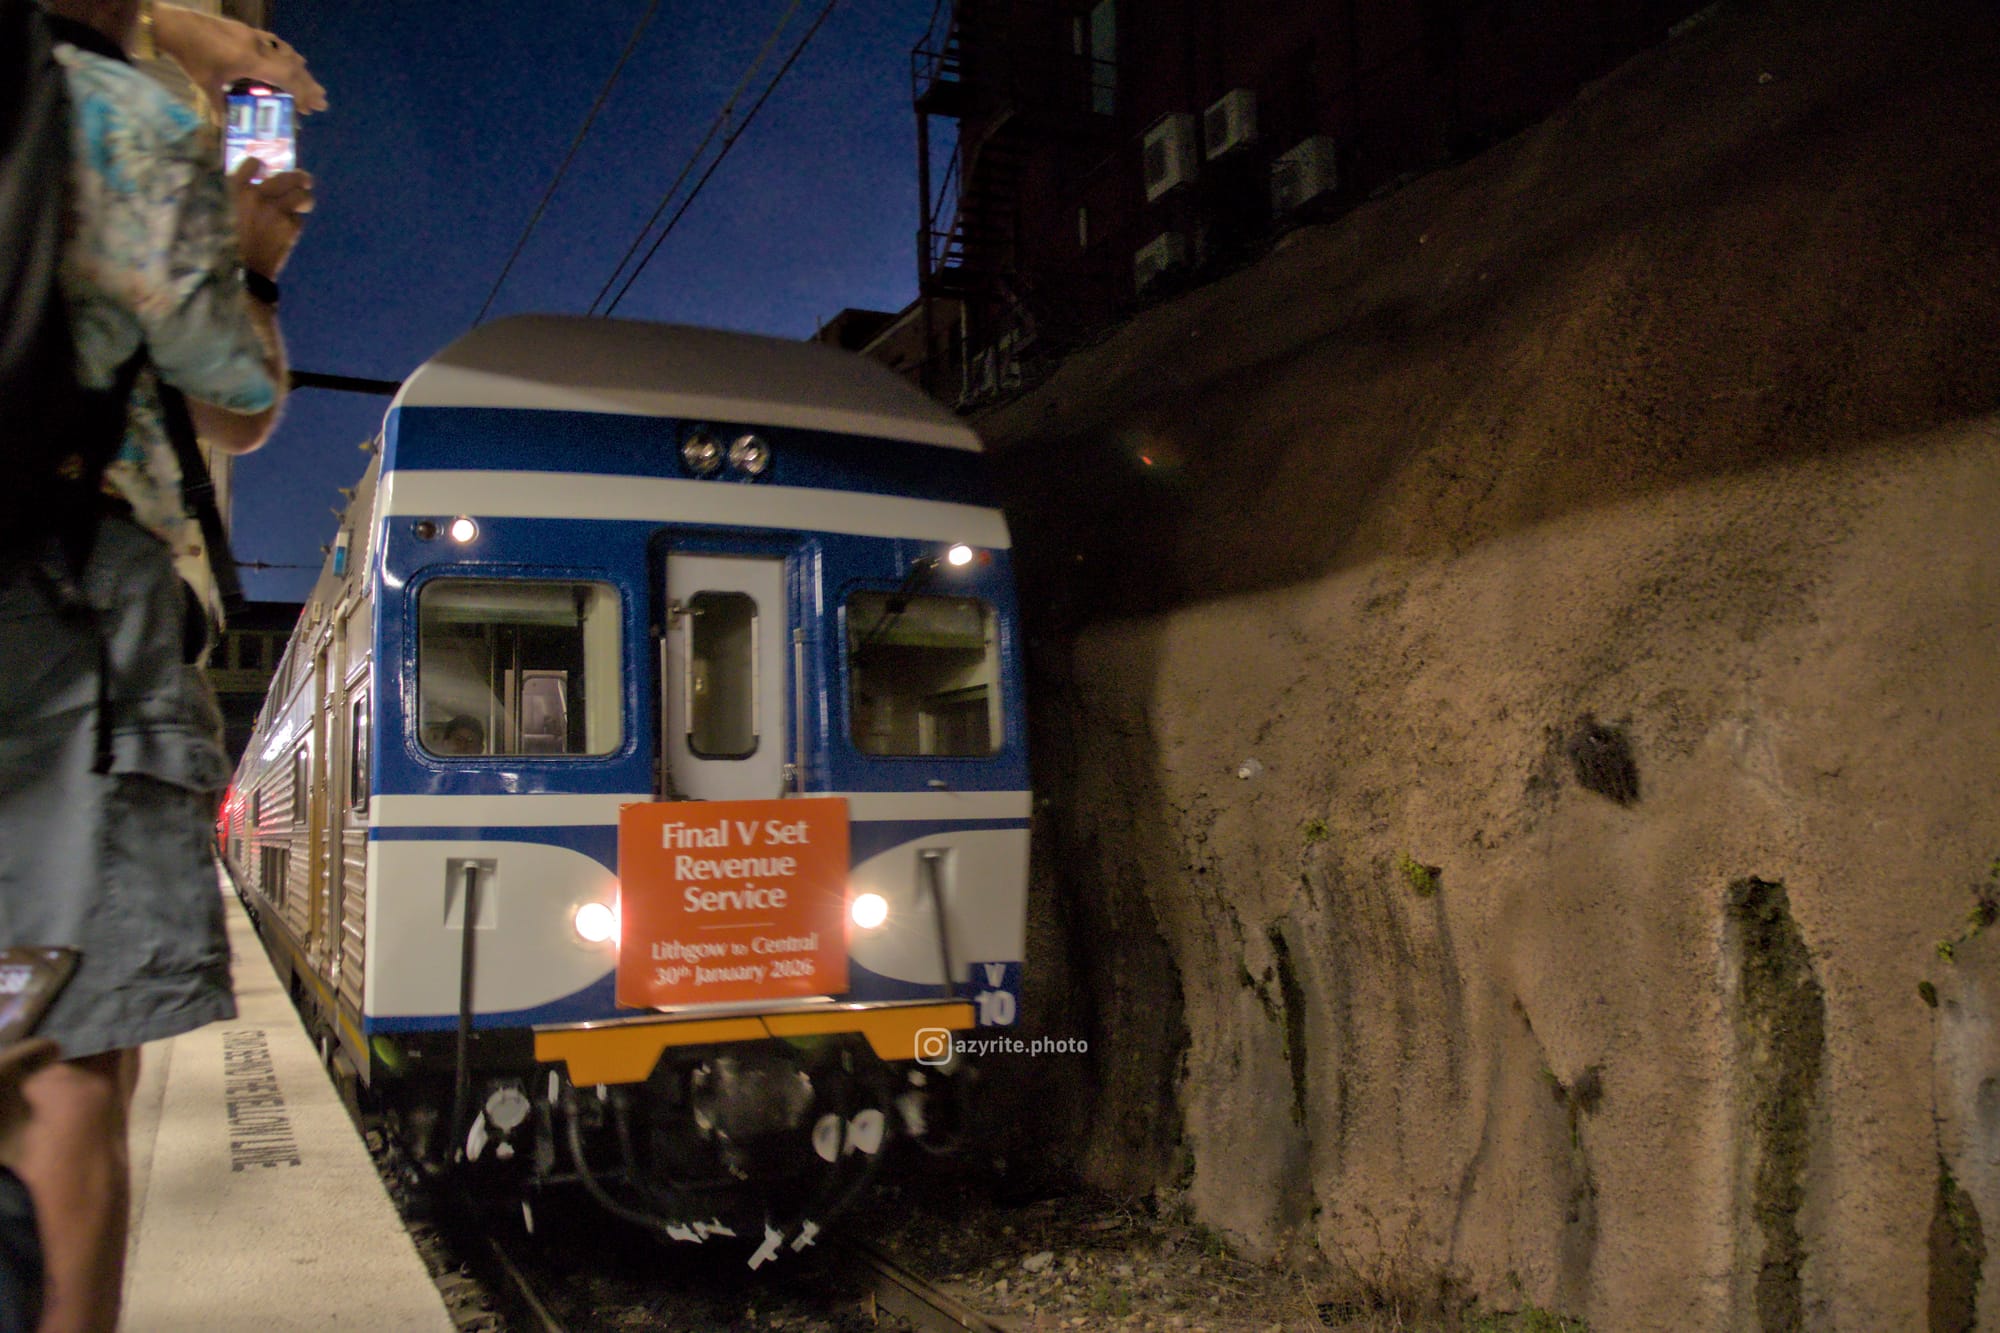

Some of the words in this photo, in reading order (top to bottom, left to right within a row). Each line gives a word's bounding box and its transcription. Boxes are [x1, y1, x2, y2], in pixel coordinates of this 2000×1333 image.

[662, 820, 729, 849] Final
[735, 821, 759, 846] V
[764, 820, 810, 845] Set
[674, 855, 797, 881] Revenue
[683, 882, 788, 913] Service
[652, 939, 728, 963] Lithgow
[731, 944, 748, 956] to
[751, 932, 819, 954] Central
[655, 967, 691, 986] 30th
[695, 965, 767, 985] January
[769, 957, 816, 978] 2026
[983, 963, 1007, 988] V
[974, 990, 1017, 1026] 10
[224, 1075, 279, 1094] THE
[226, 1092, 293, 1137] YELLOW
[230, 1137, 302, 1172] LINE
